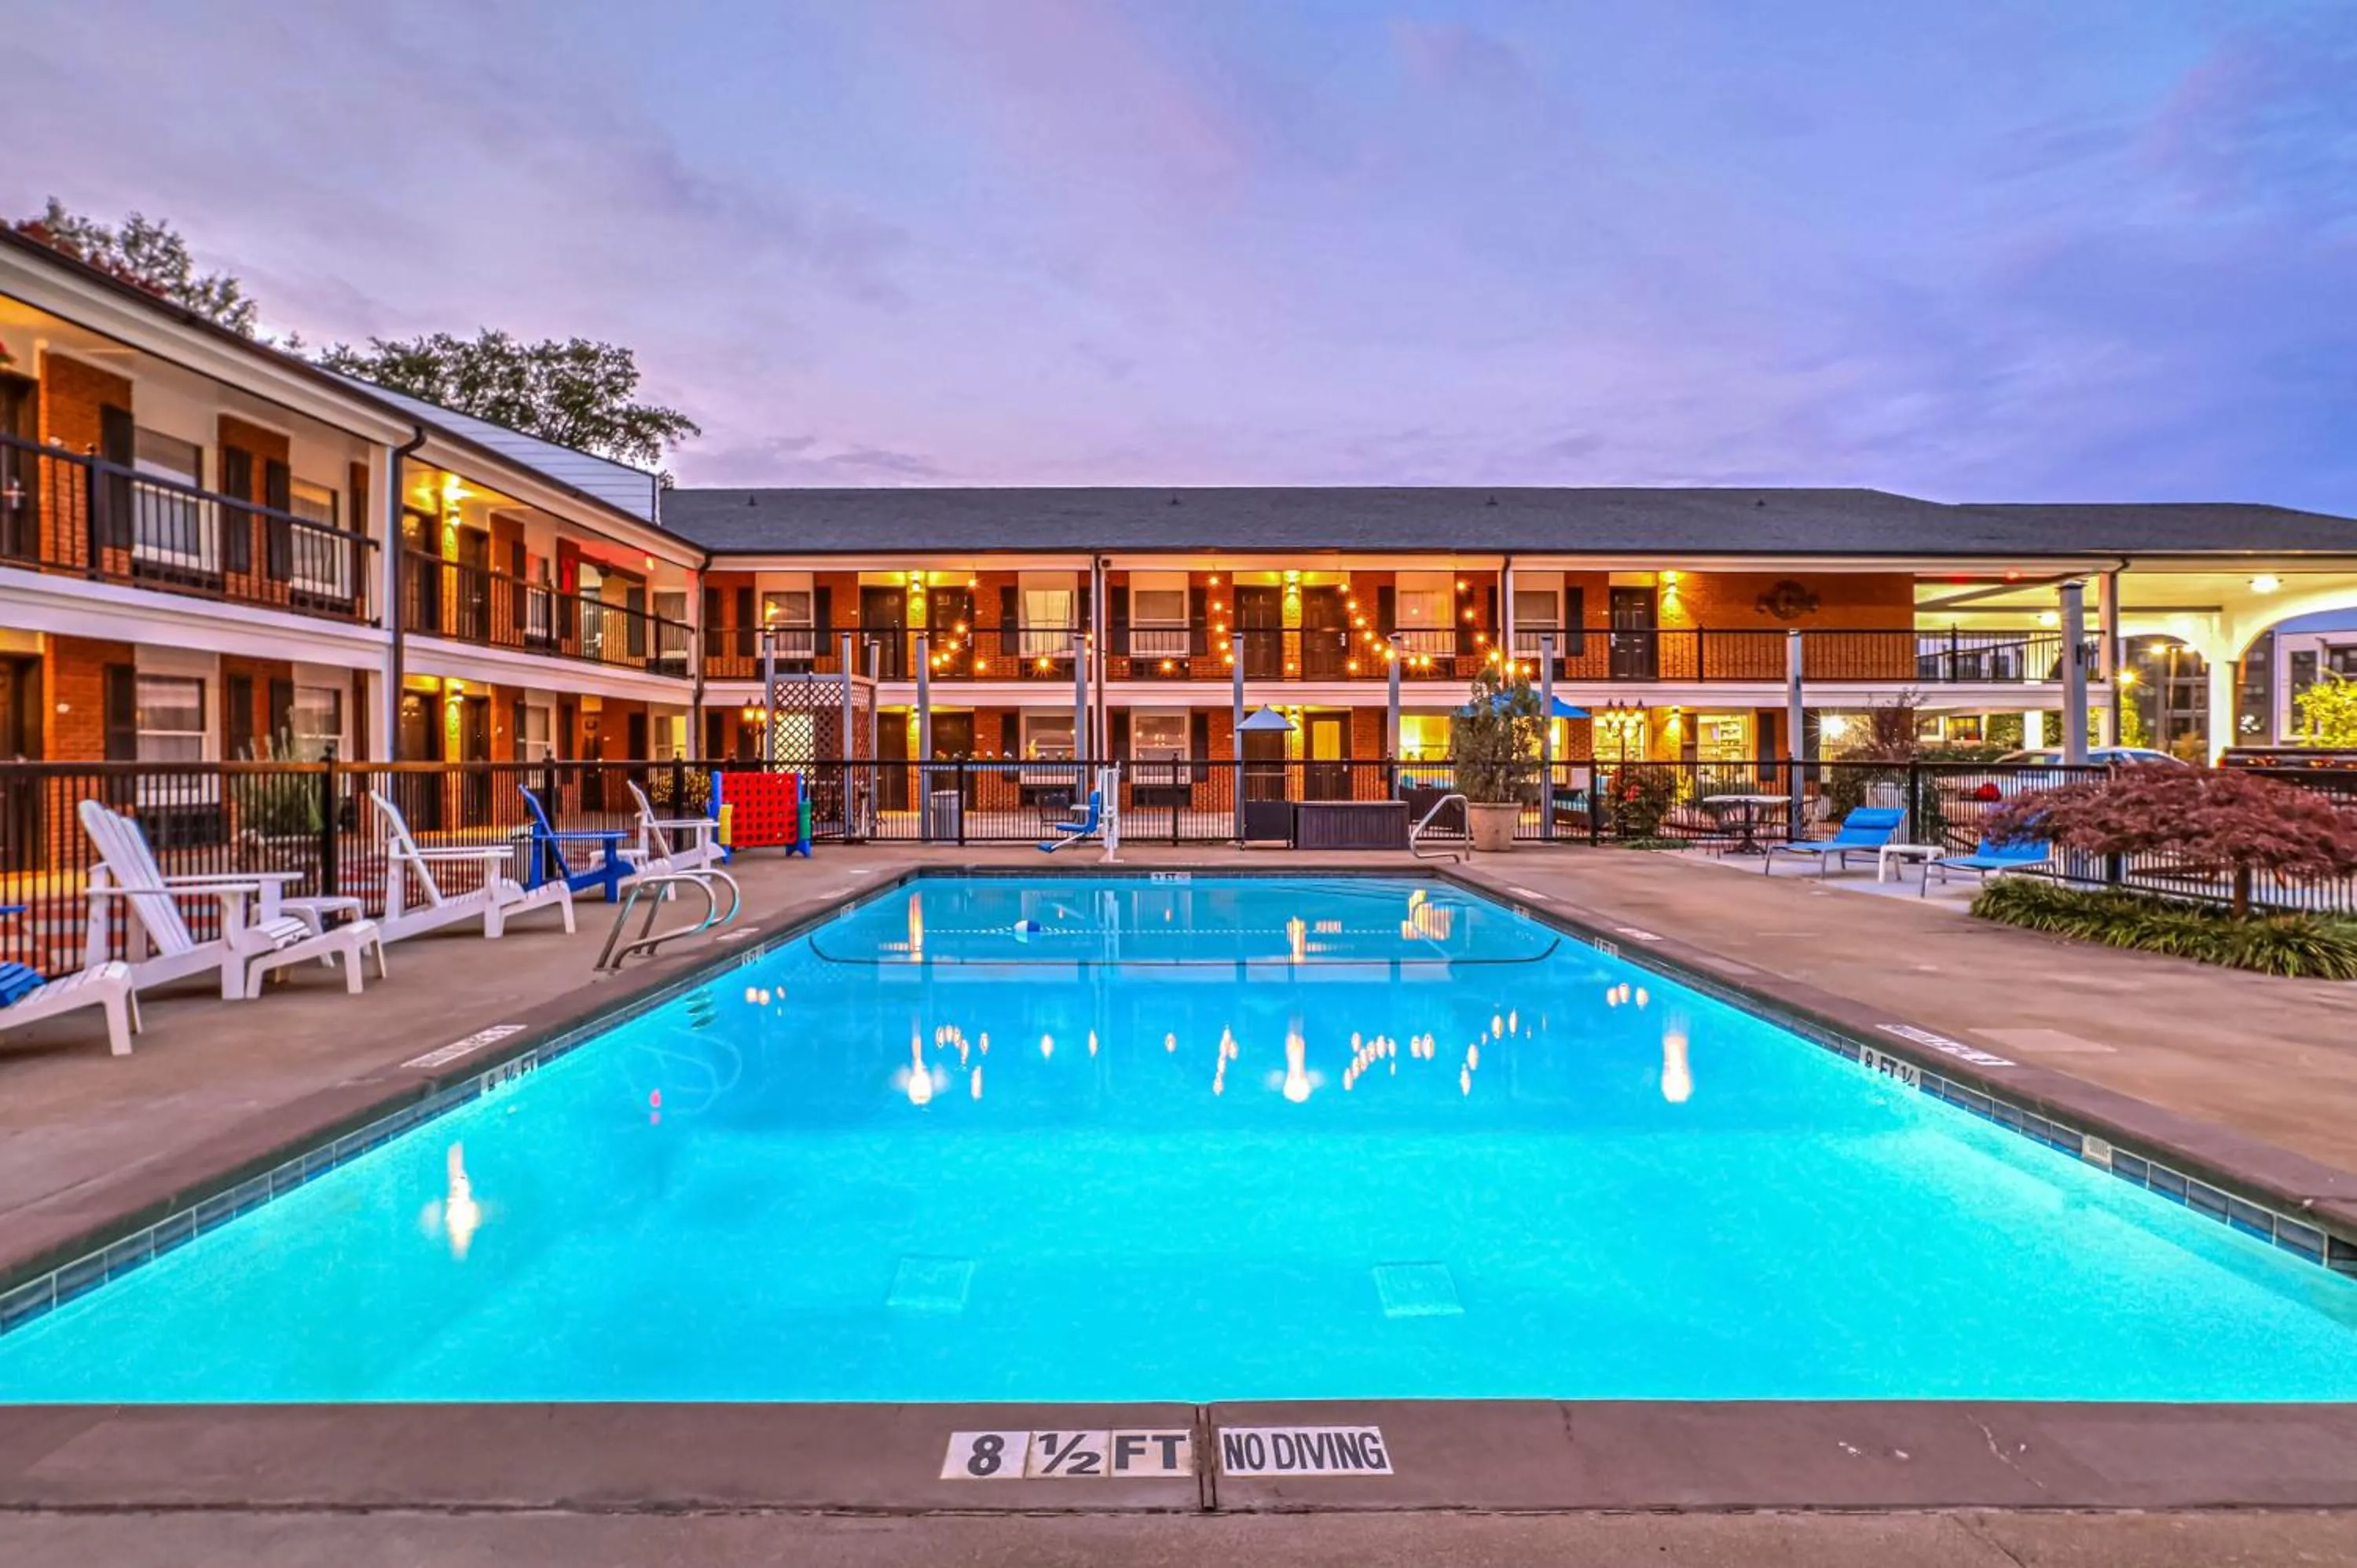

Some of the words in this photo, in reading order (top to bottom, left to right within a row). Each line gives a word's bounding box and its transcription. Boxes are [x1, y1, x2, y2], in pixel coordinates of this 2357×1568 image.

[1879, 1055, 1897, 1079] FT
[967, 1434, 1005, 1476] 8
[1115, 1434, 1187, 1470] FT
[1222, 1432, 1266, 1471] NO
[1270, 1431, 1388, 1471] DIVING
